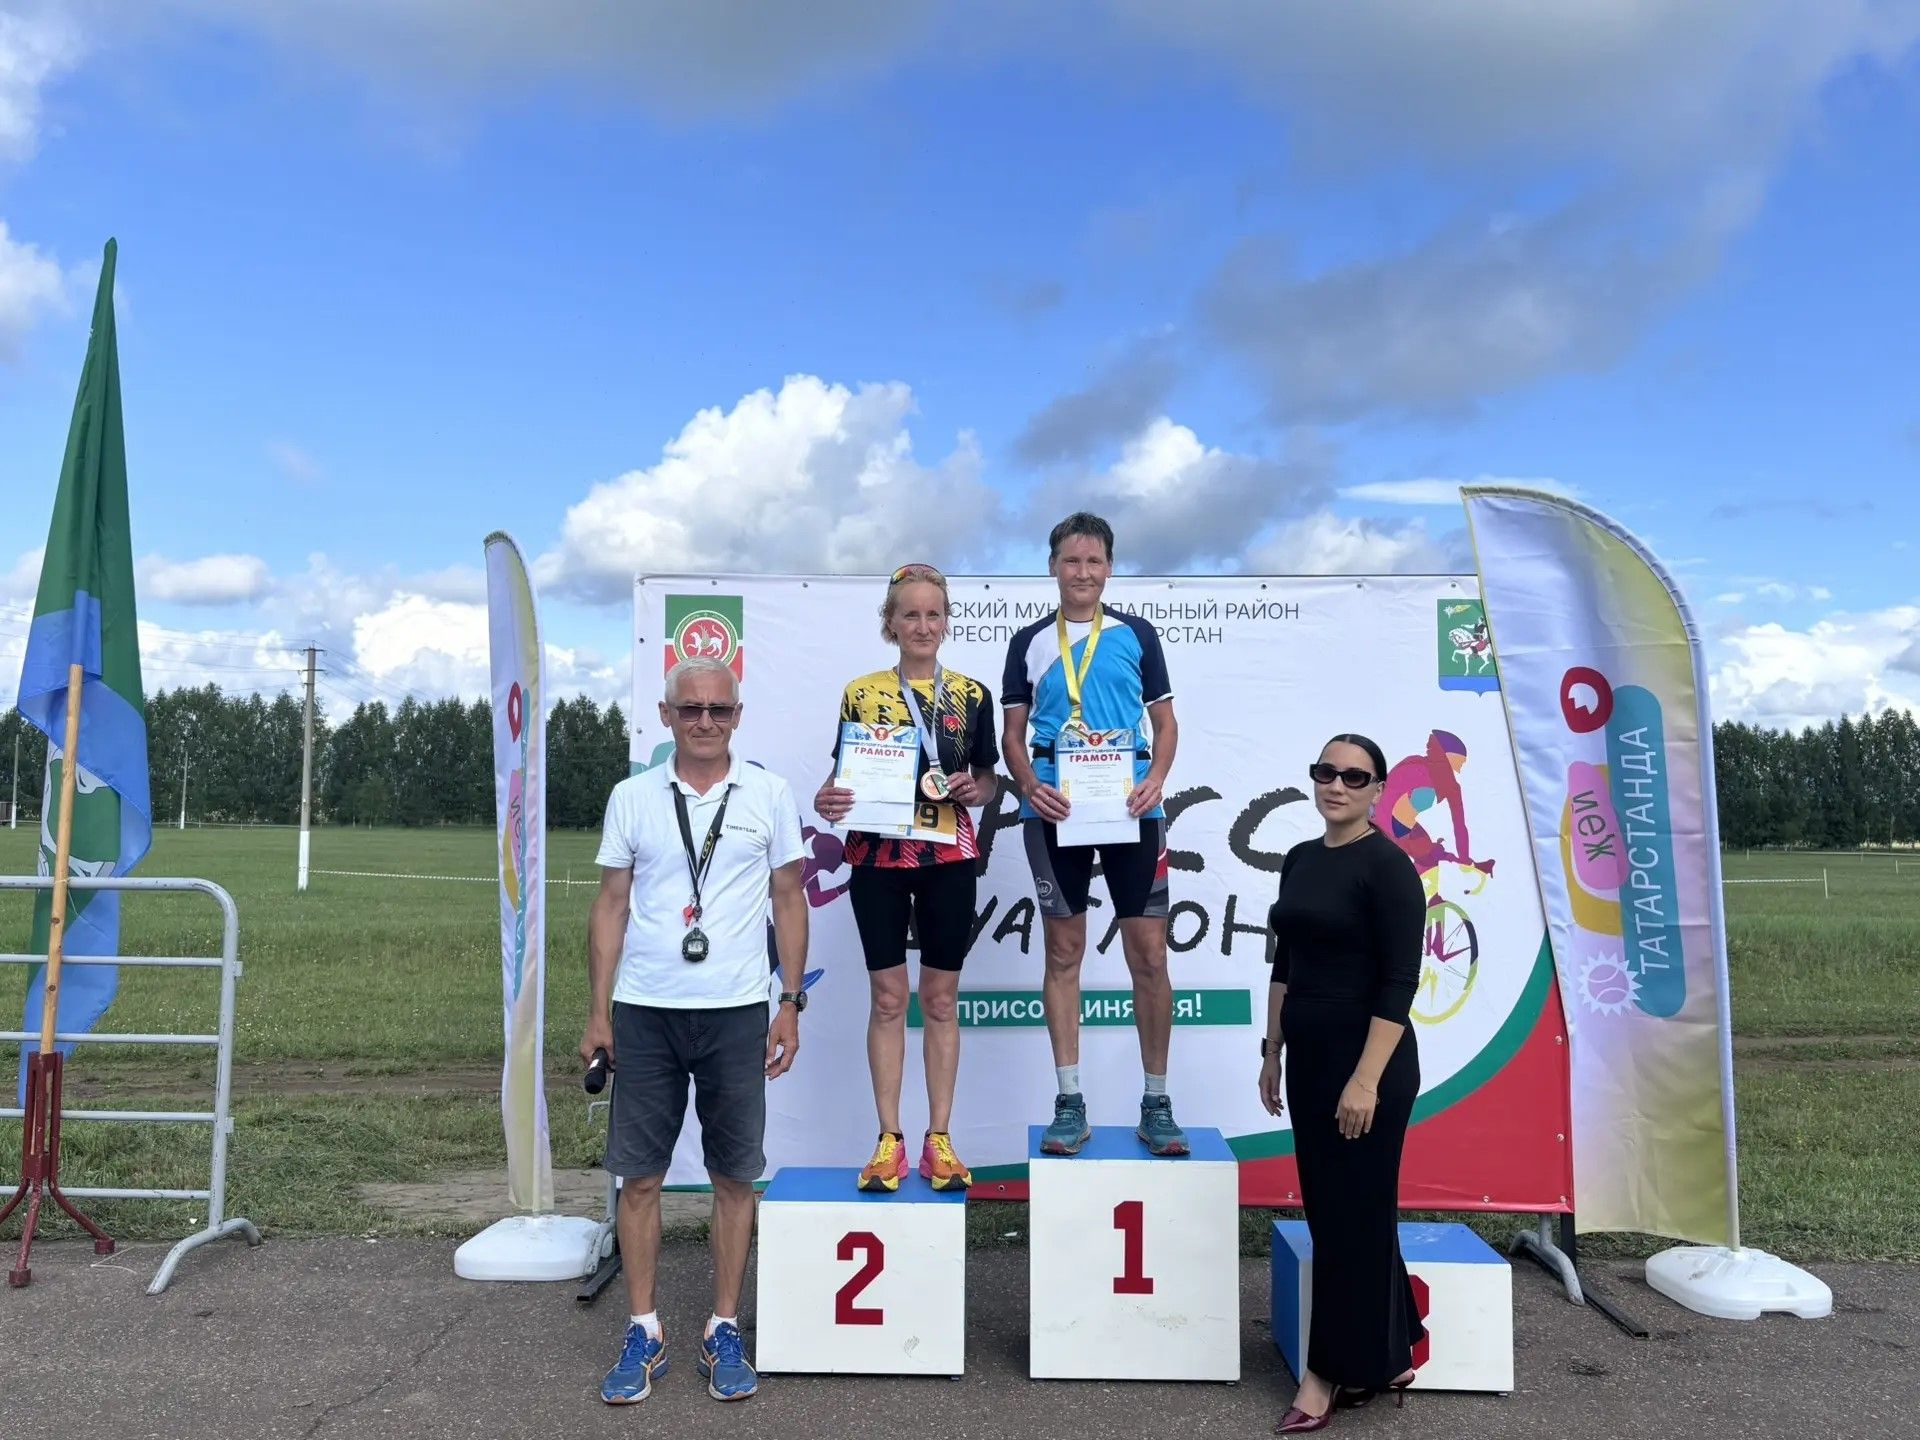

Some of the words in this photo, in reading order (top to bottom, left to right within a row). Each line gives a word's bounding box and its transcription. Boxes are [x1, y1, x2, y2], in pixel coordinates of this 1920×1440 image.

[949, 597, 1007, 619] СКИЙ
[1015, 597, 1218, 620] МУНПАЛЬНЫЙ
[1225, 597, 1299, 620] РАЙОН
[953, 625, 1023, 642] РЕСПУ
[1155, 625, 1223, 644] РСТАН
[854, 745, 905, 758] ГРАМОТА
[1069, 753, 1122, 763] ГРАМОТА
[1618, 726, 1670, 975] ТАТАРСТАНДА
[956, 992, 1203, 1026] присоиняя!
[1113, 1200, 1154, 1295] 1
[835, 1231, 885, 1326] 2
